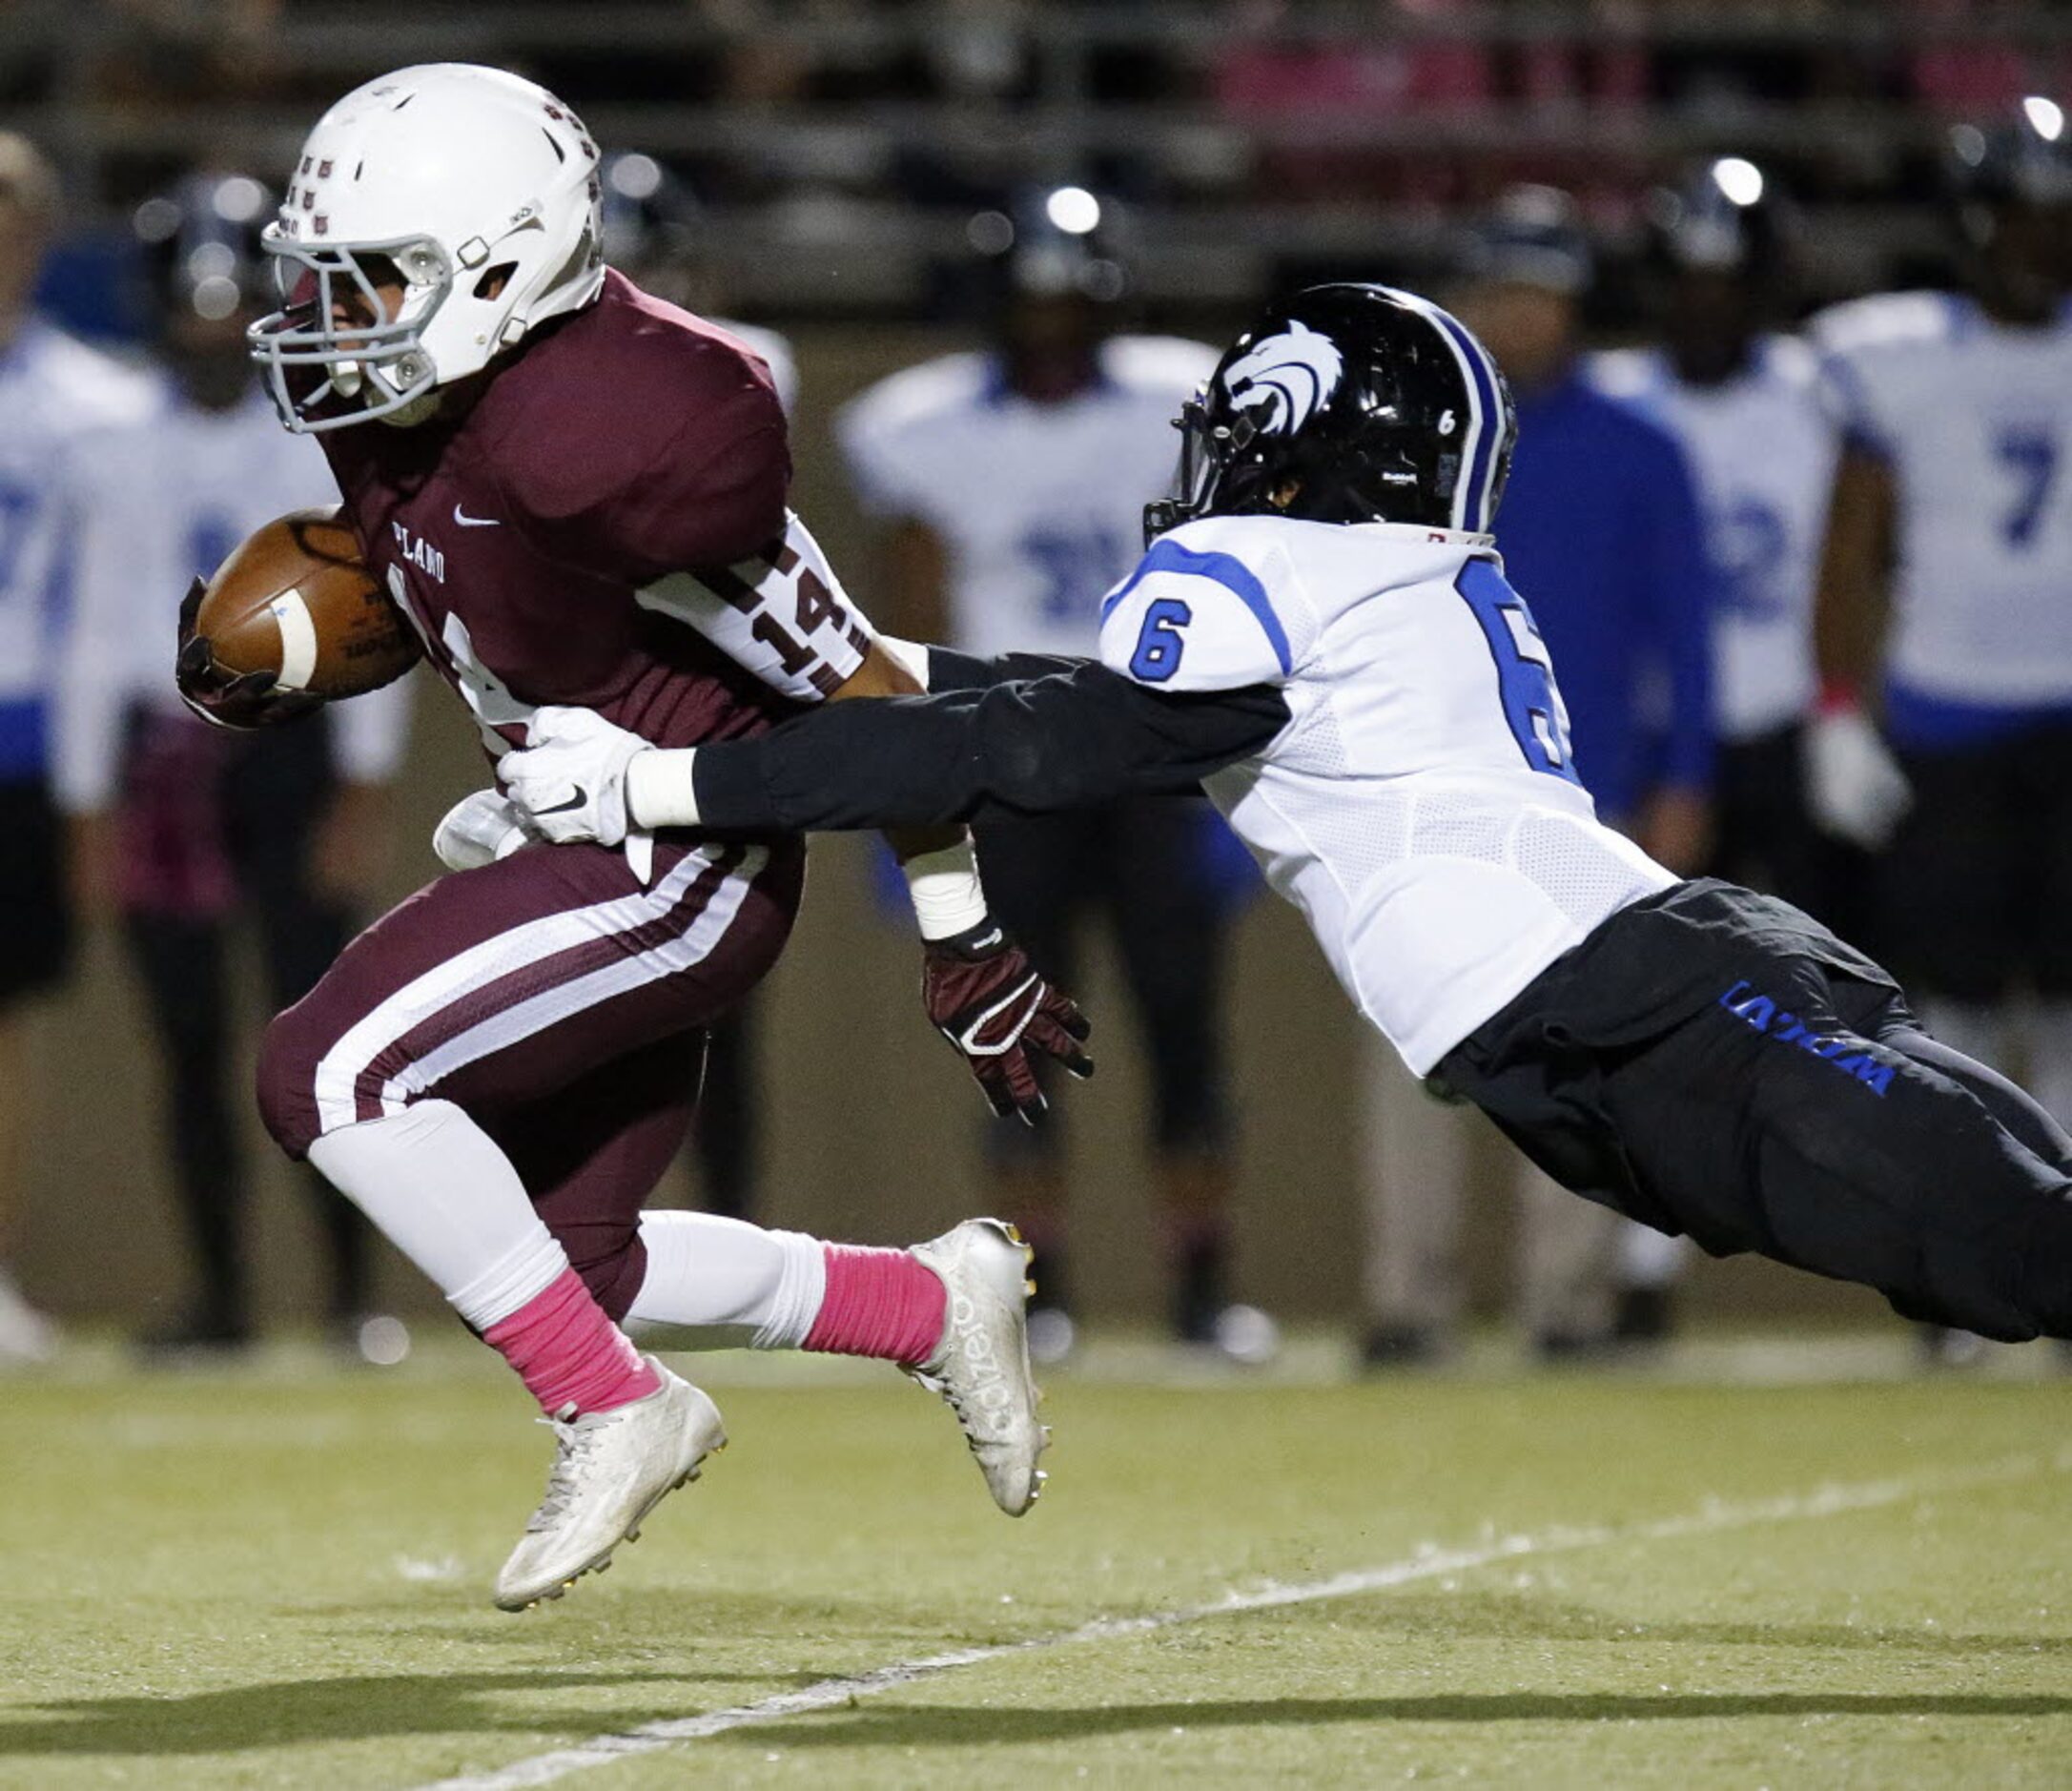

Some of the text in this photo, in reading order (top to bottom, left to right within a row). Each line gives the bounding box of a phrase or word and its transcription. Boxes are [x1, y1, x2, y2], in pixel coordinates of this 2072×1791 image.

[1438, 409, 1456, 435] 6
[752, 566, 847, 676] 14
[1129, 598, 1192, 682] 6
